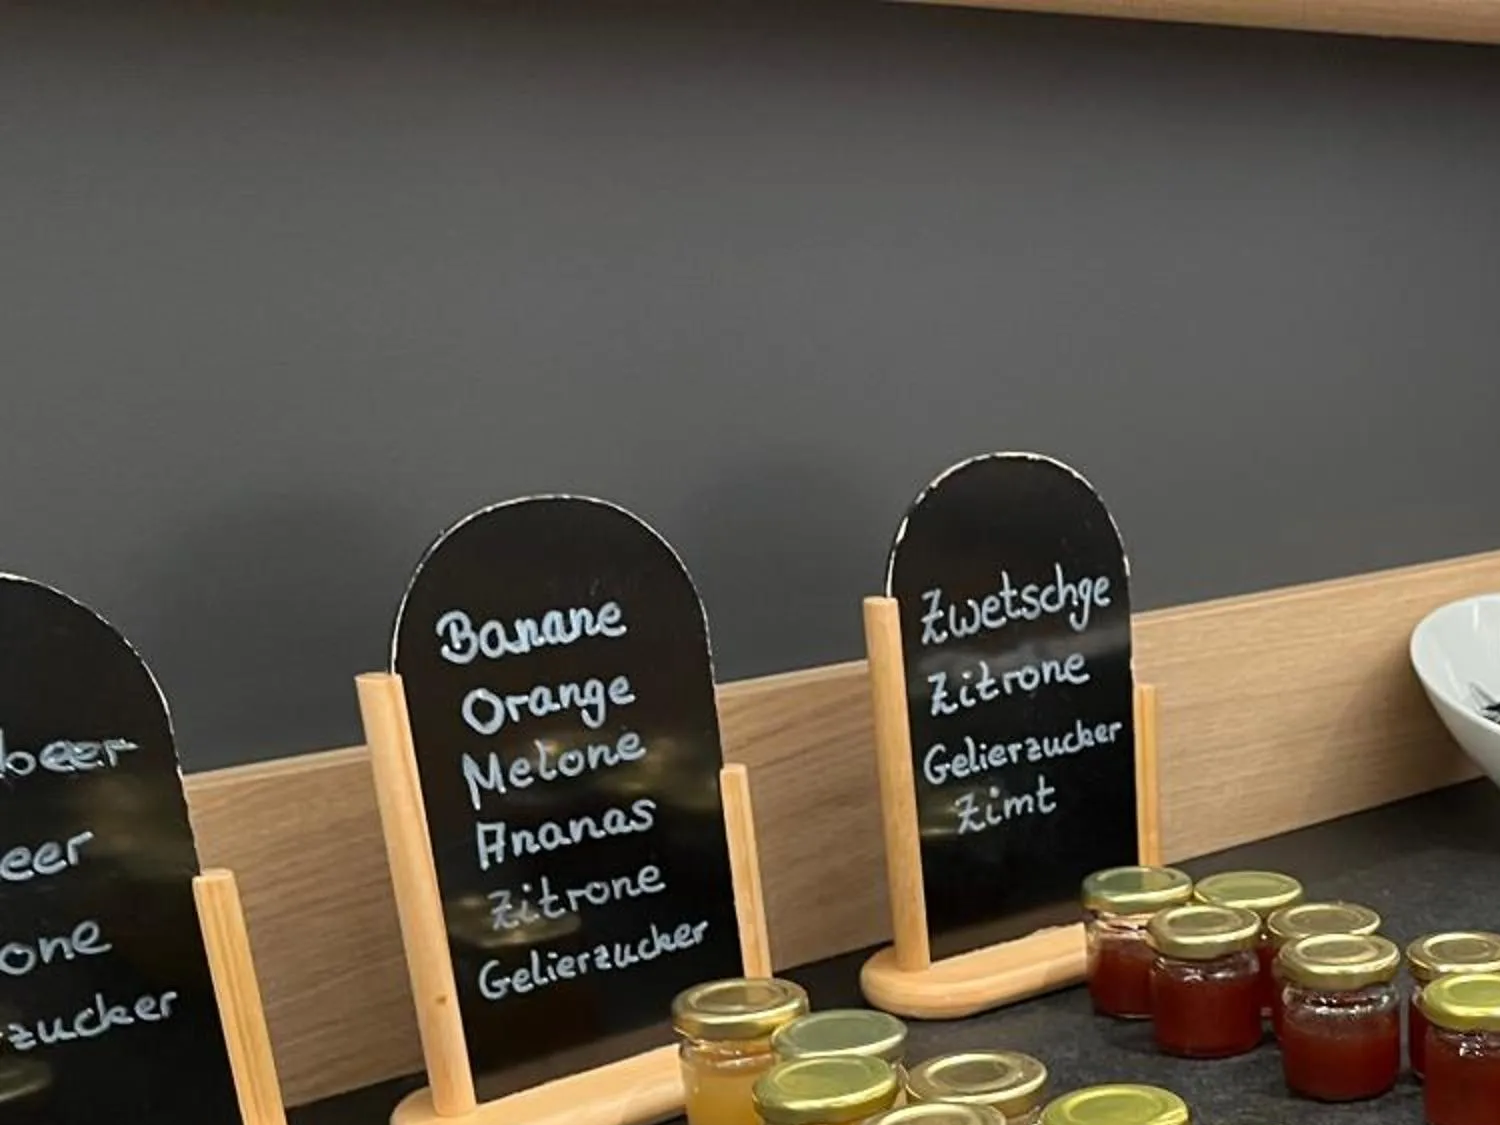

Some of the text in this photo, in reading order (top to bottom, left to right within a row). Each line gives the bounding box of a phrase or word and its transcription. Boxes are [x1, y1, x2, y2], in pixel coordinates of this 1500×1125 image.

[436, 600, 627, 664] Banane
[921, 562, 1111, 645] Zwetschge
[461, 673, 636, 730] Orange
[928, 652, 1090, 717] Zitrone
[462, 730, 647, 811] Melone
[923, 719, 1123, 785] Gelierzucker
[476, 799, 657, 871] Ananas
[956, 775, 1057, 835] Zimt
[488, 864, 667, 930] Zitrone
[478, 917, 709, 1000] Gelierzucker
[0, 991, 178, 1050] zucker
